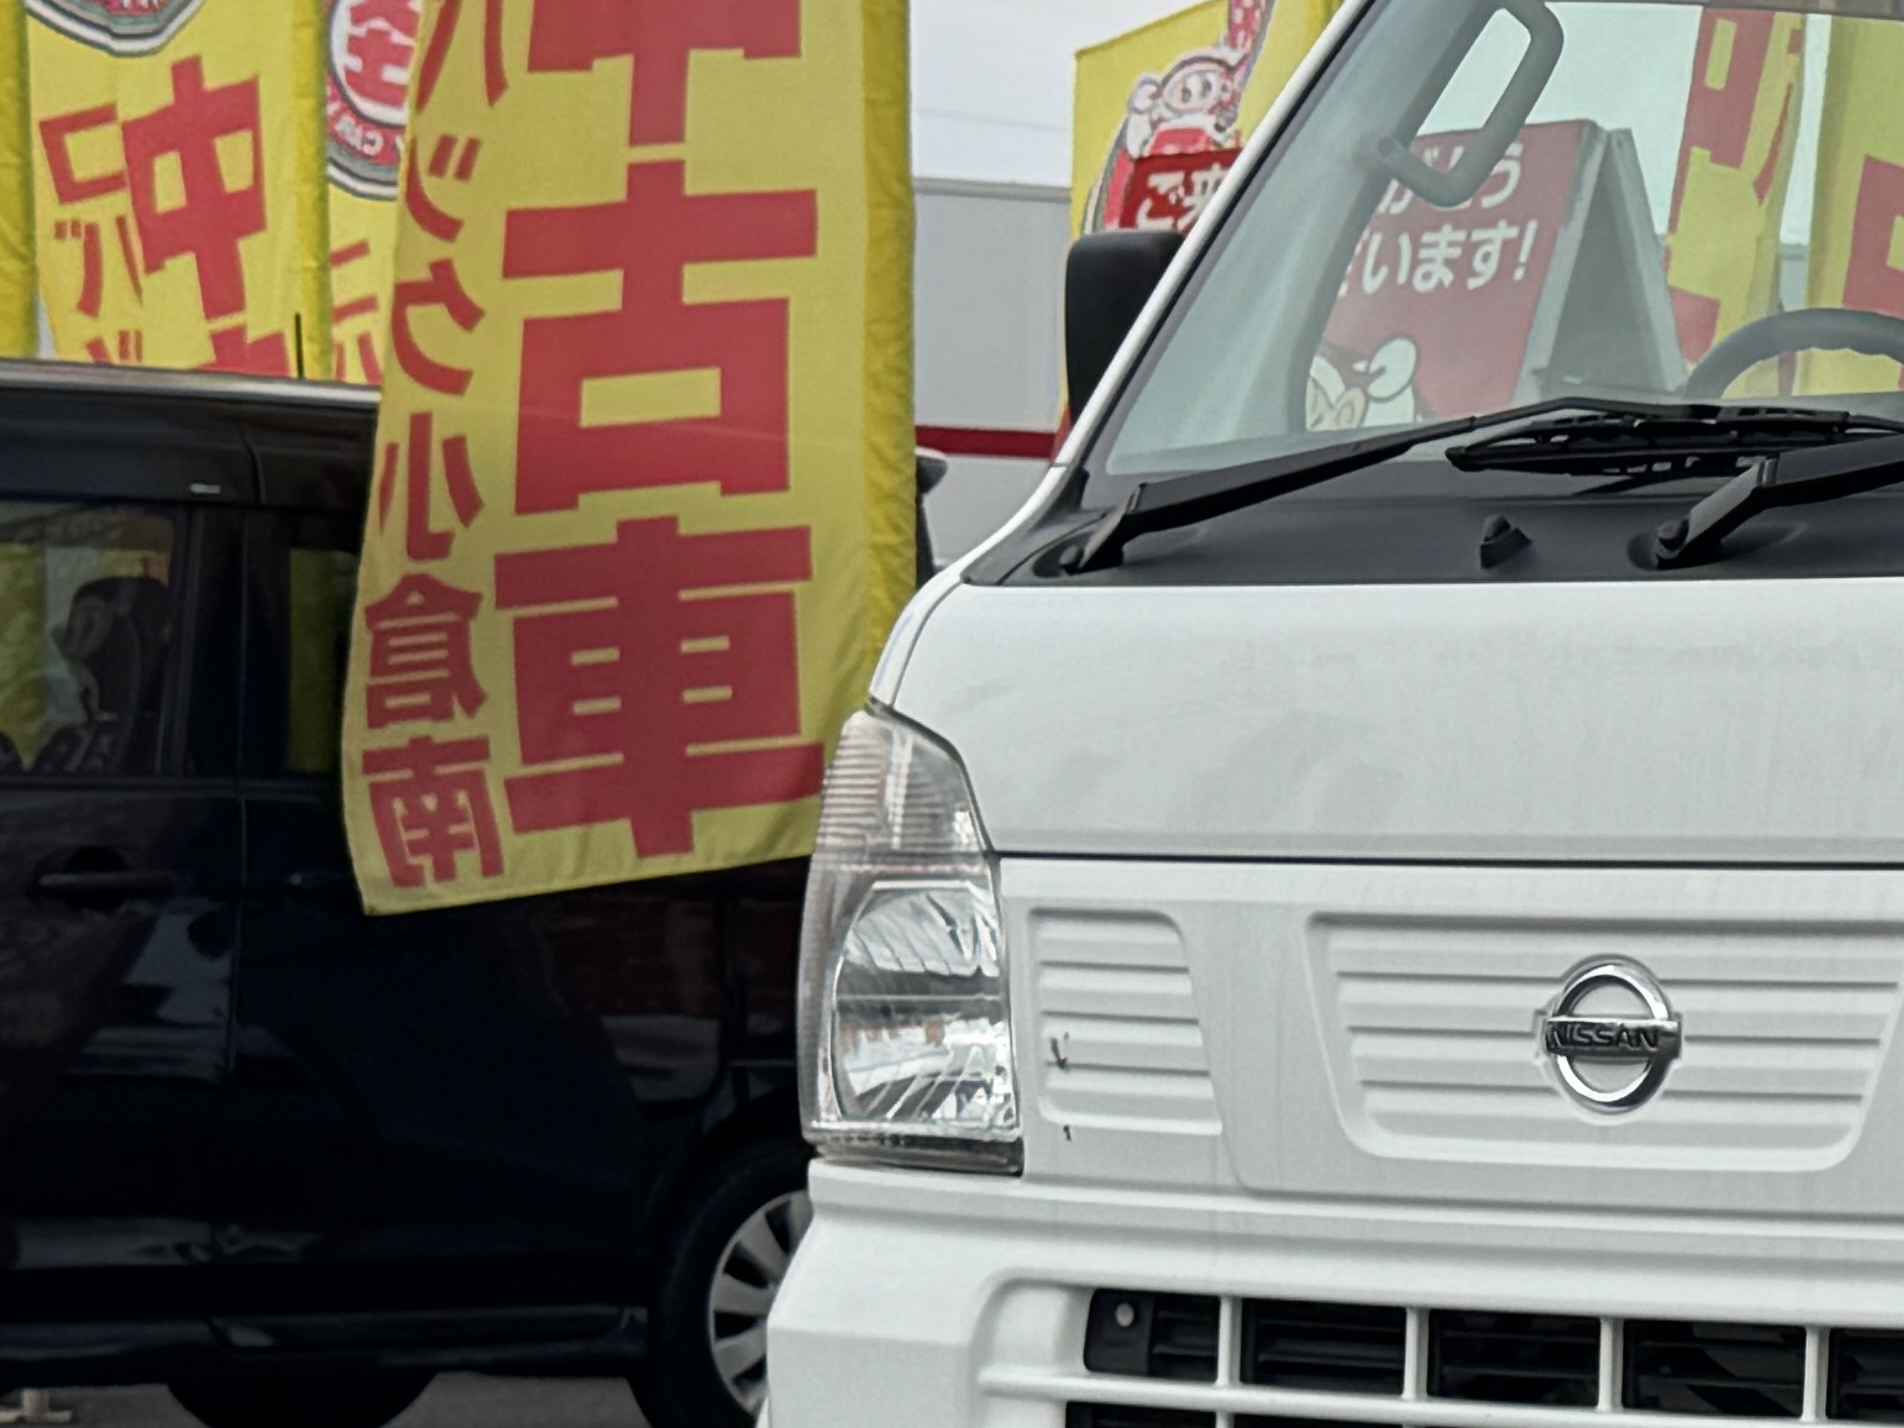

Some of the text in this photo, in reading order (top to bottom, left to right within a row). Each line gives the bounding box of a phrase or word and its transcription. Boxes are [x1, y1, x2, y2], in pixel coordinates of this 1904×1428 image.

[1337, 219, 1539, 298] います!
[1545, 1022, 1660, 1054] NISSAN
